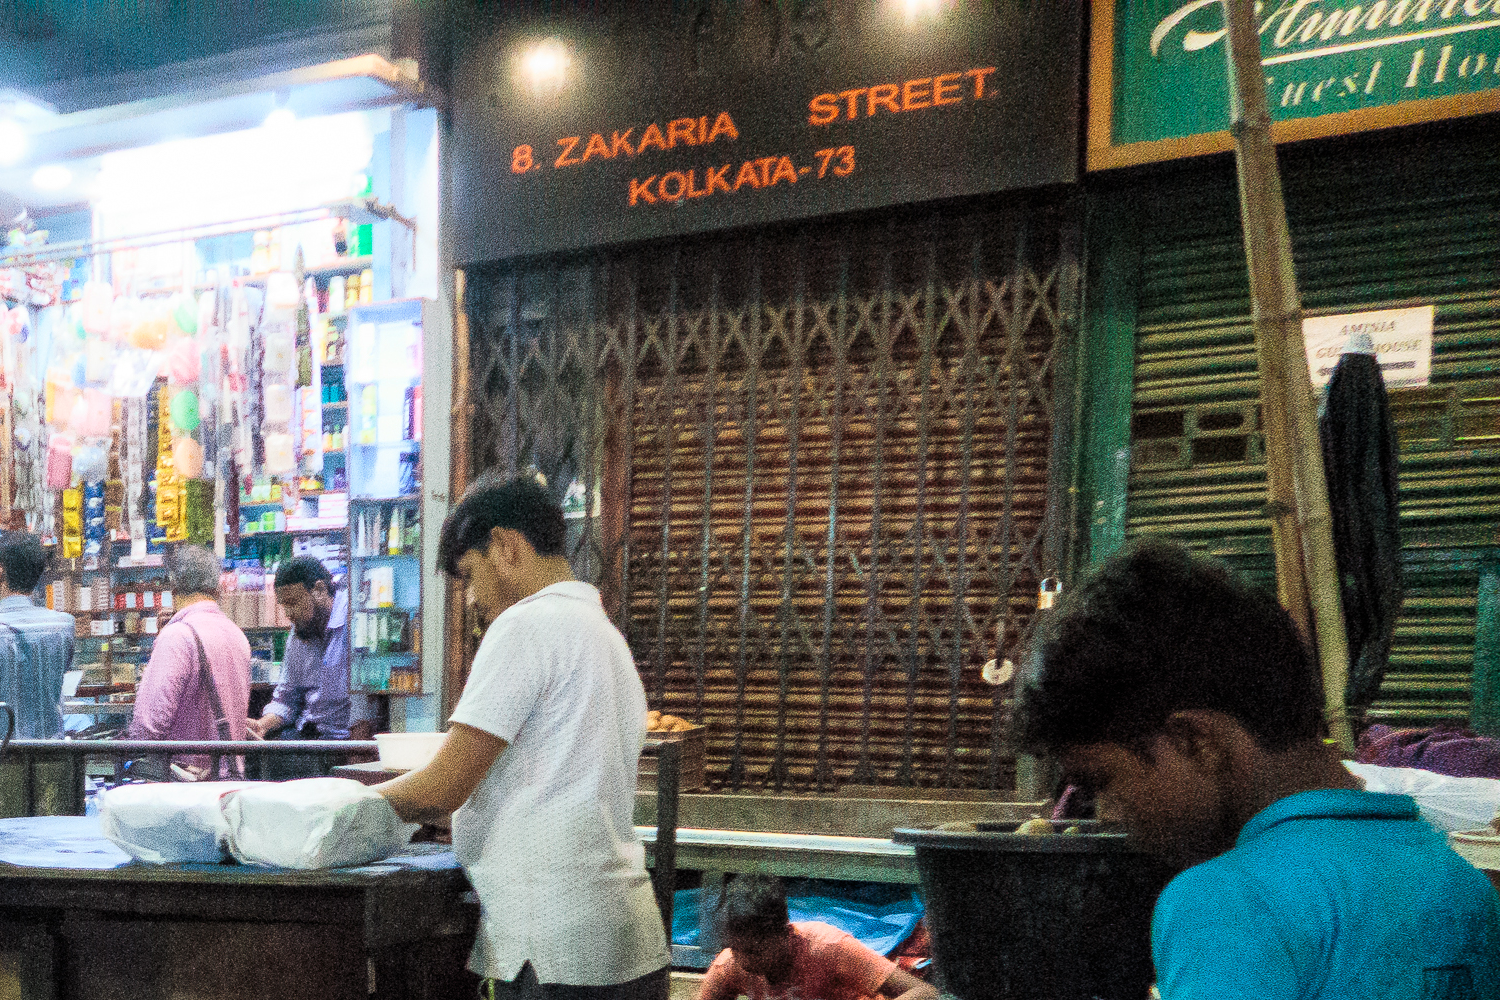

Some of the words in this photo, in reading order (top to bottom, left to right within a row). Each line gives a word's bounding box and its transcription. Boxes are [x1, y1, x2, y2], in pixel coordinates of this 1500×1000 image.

[1264, 60, 1383, 107] uest
[511, 144, 543, 174] 8.
[555, 111, 739, 169] ZAKARIA
[628, 145, 856, 206] KOLKATA-73
